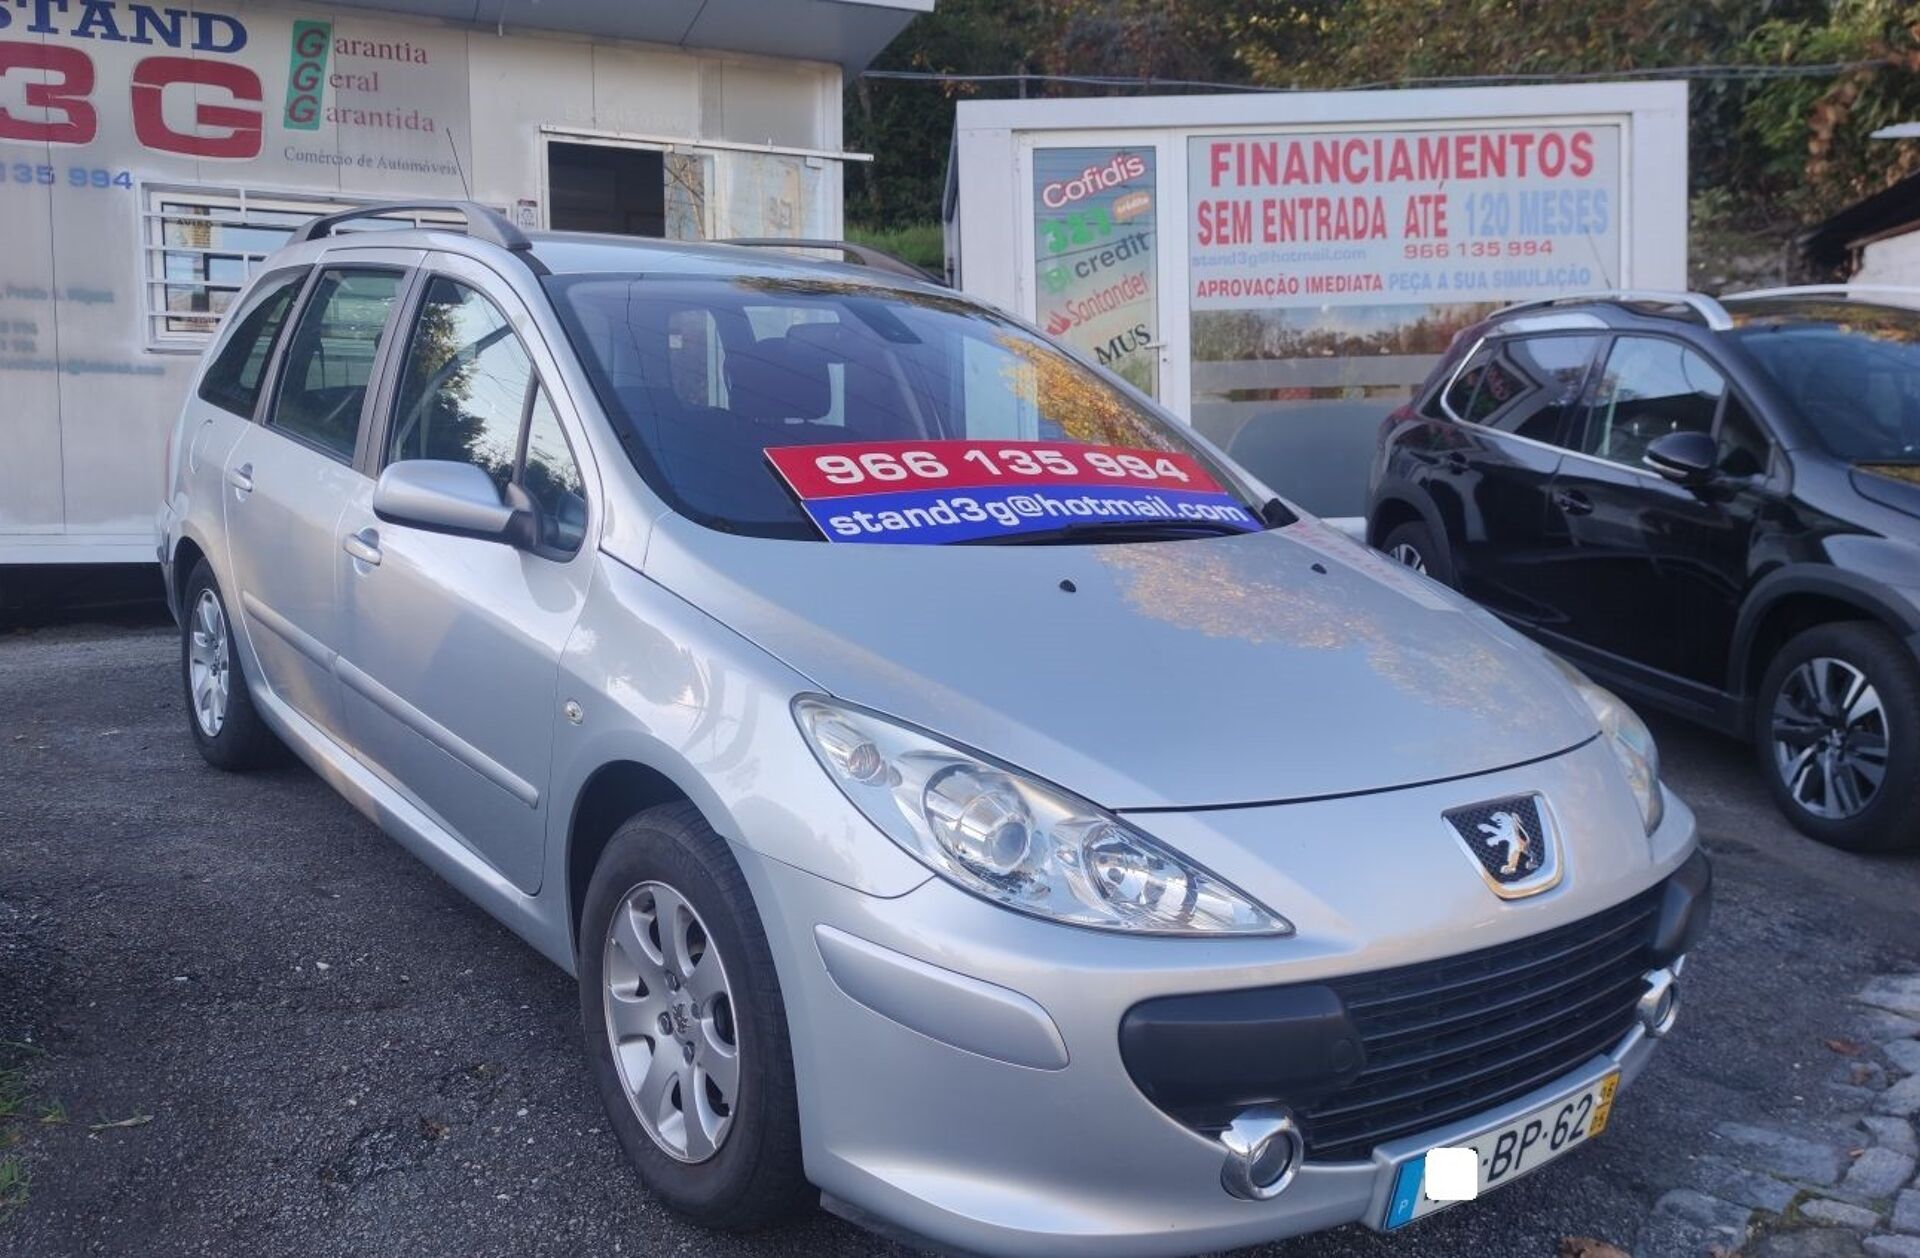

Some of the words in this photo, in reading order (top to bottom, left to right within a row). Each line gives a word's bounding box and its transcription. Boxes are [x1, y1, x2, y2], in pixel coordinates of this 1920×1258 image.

[284, 146, 352, 166] Comércio
[357, 153, 372, 167] de
[377, 157, 458, 176] Automóveis
[1210, 131, 1594, 188] FINANCIAMENTOS
[68, 168, 133, 189] 994
[1042, 157, 1146, 209] Cofidis
[1197, 200, 1253, 246] SEM
[1262, 196, 1388, 243] ENTRADA
[1404, 180, 1448, 239] ATÉ
[1464, 191, 1511, 237] 120
[1518, 188, 1610, 236] MESES
[1191, 247, 1367, 267] stand3g@hotmail.com
[1403, 243, 1449, 260] 966
[1456, 241, 1501, 257] 135
[1507, 239, 1553, 256] 994
[1065, 271, 1150, 327] Santander
[1196, 273, 1300, 299] APROVAÇÃO
[1305, 274, 1384, 294] IMEDIATA
[1388, 271, 1432, 295] PEÇA
[1436, 272, 1450, 290] A
[1453, 271, 1489, 290] SUA
[1492, 264, 1593, 291] SIMULAÇÃO
[814, 450, 949, 484] 966
[962, 448, 1080, 478] 135
[1082, 452, 1191, 484] 994
[828, 492, 1250, 537] stand3g@hotmail.com
